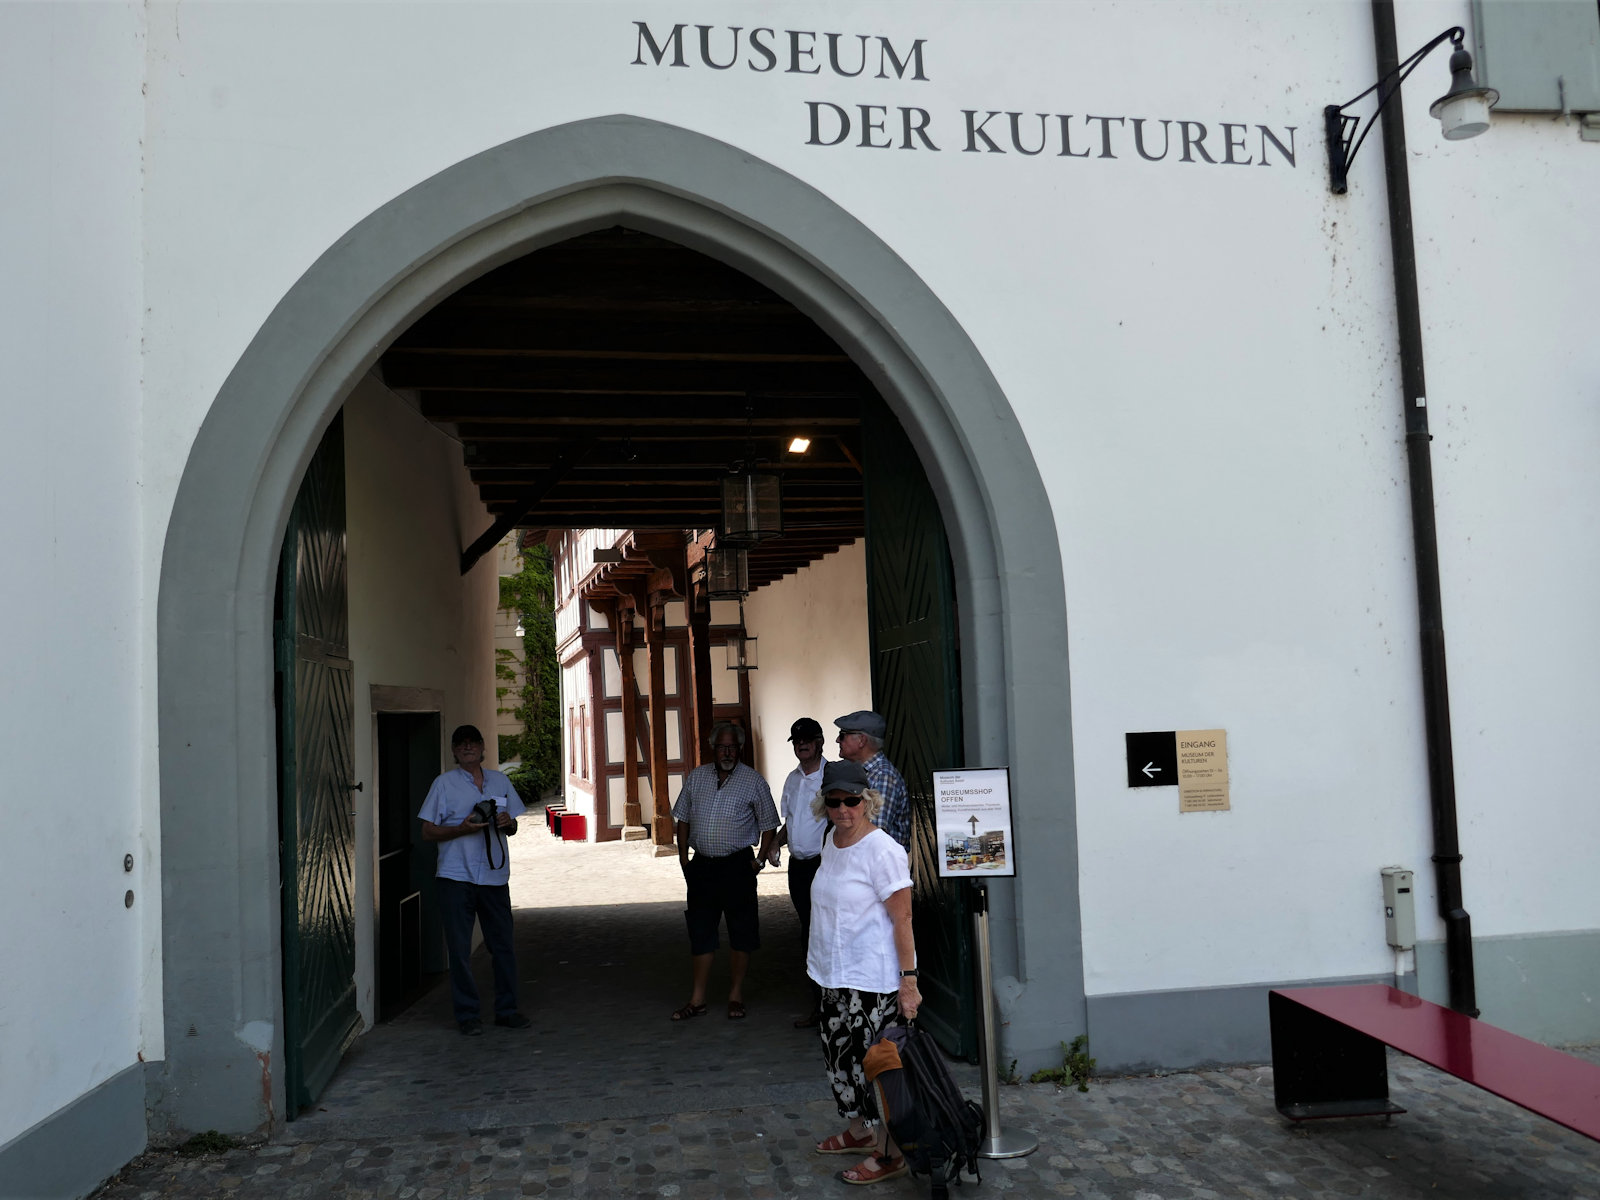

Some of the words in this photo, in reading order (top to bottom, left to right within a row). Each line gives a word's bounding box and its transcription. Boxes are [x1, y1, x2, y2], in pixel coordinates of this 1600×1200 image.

[631, 21, 930, 81] MUSEUM
[804, 102, 941, 151] DER
[962, 109, 1298, 168] KULTUREN
[1180, 740, 1216, 748] EINGANG
